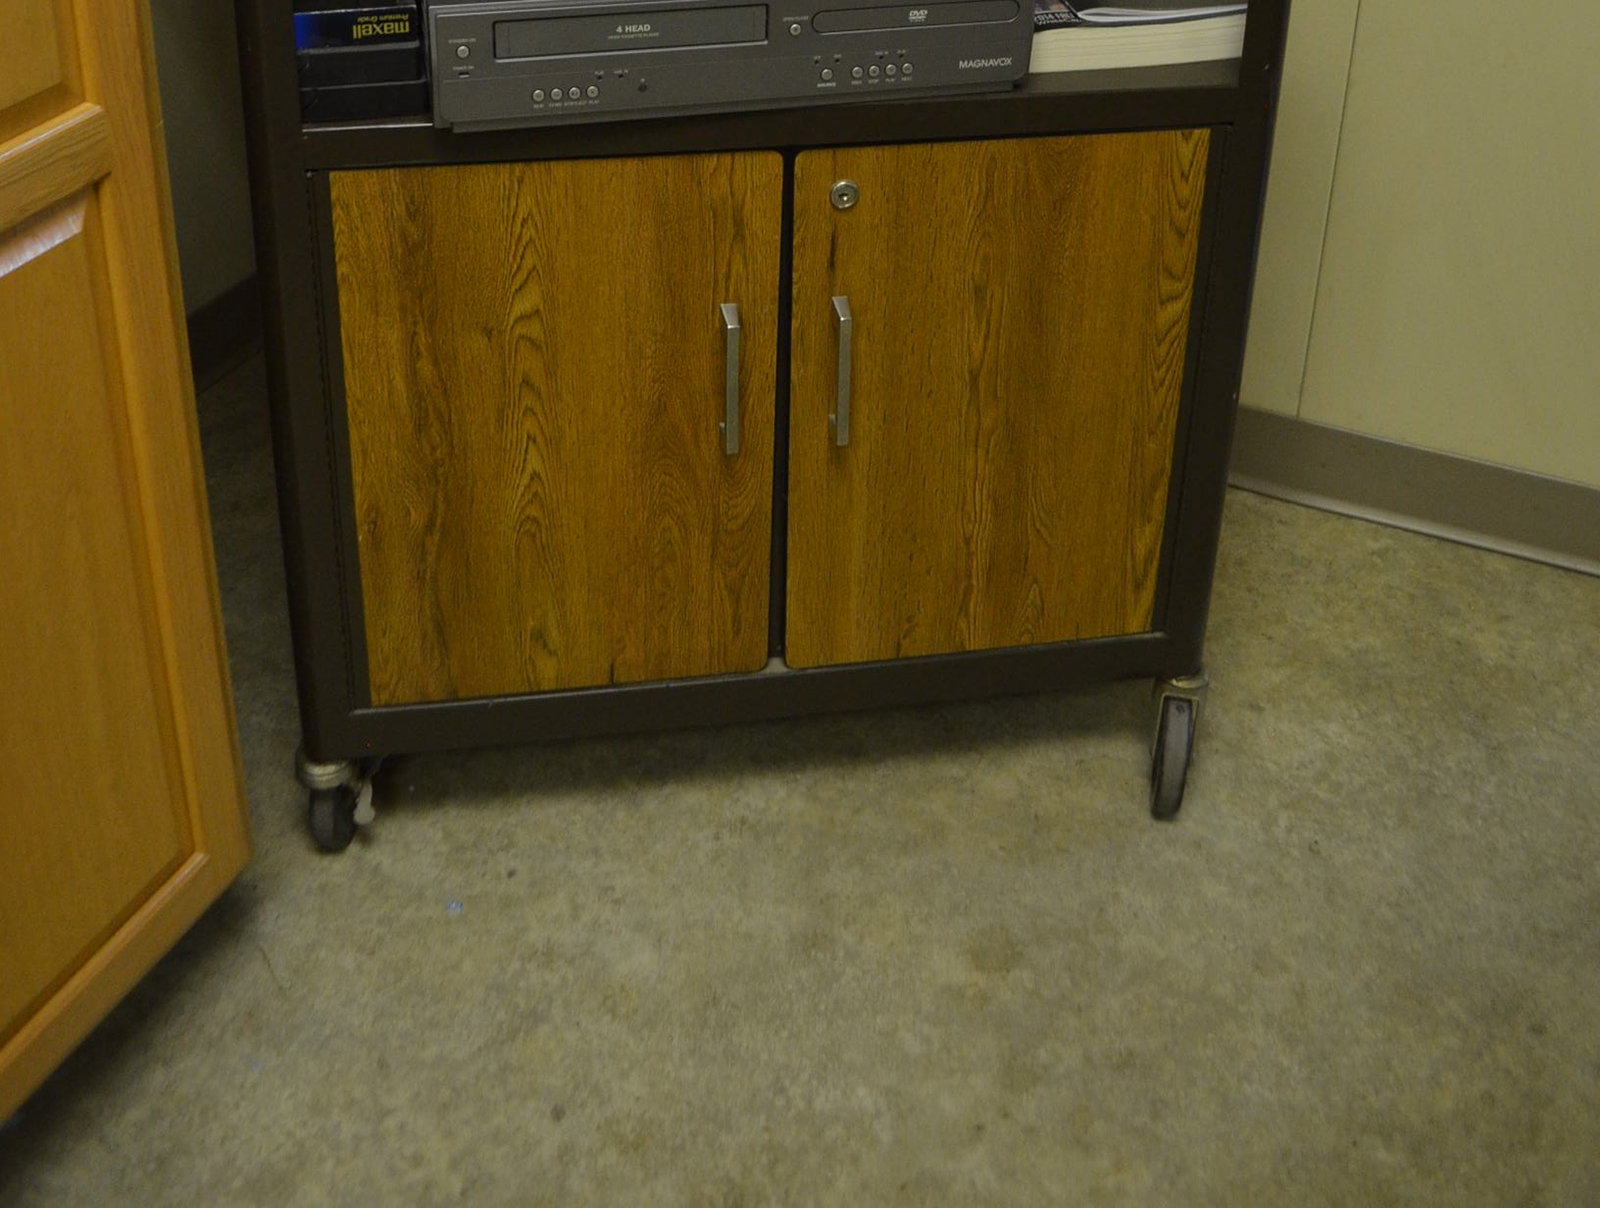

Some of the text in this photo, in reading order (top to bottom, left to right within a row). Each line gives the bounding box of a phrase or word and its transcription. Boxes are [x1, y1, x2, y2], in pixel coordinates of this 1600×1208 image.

[352, 21, 410, 40] maxell
[615, 23, 651, 33] 4 HEAD
[958, 57, 1013, 70] MAGNAVOX
